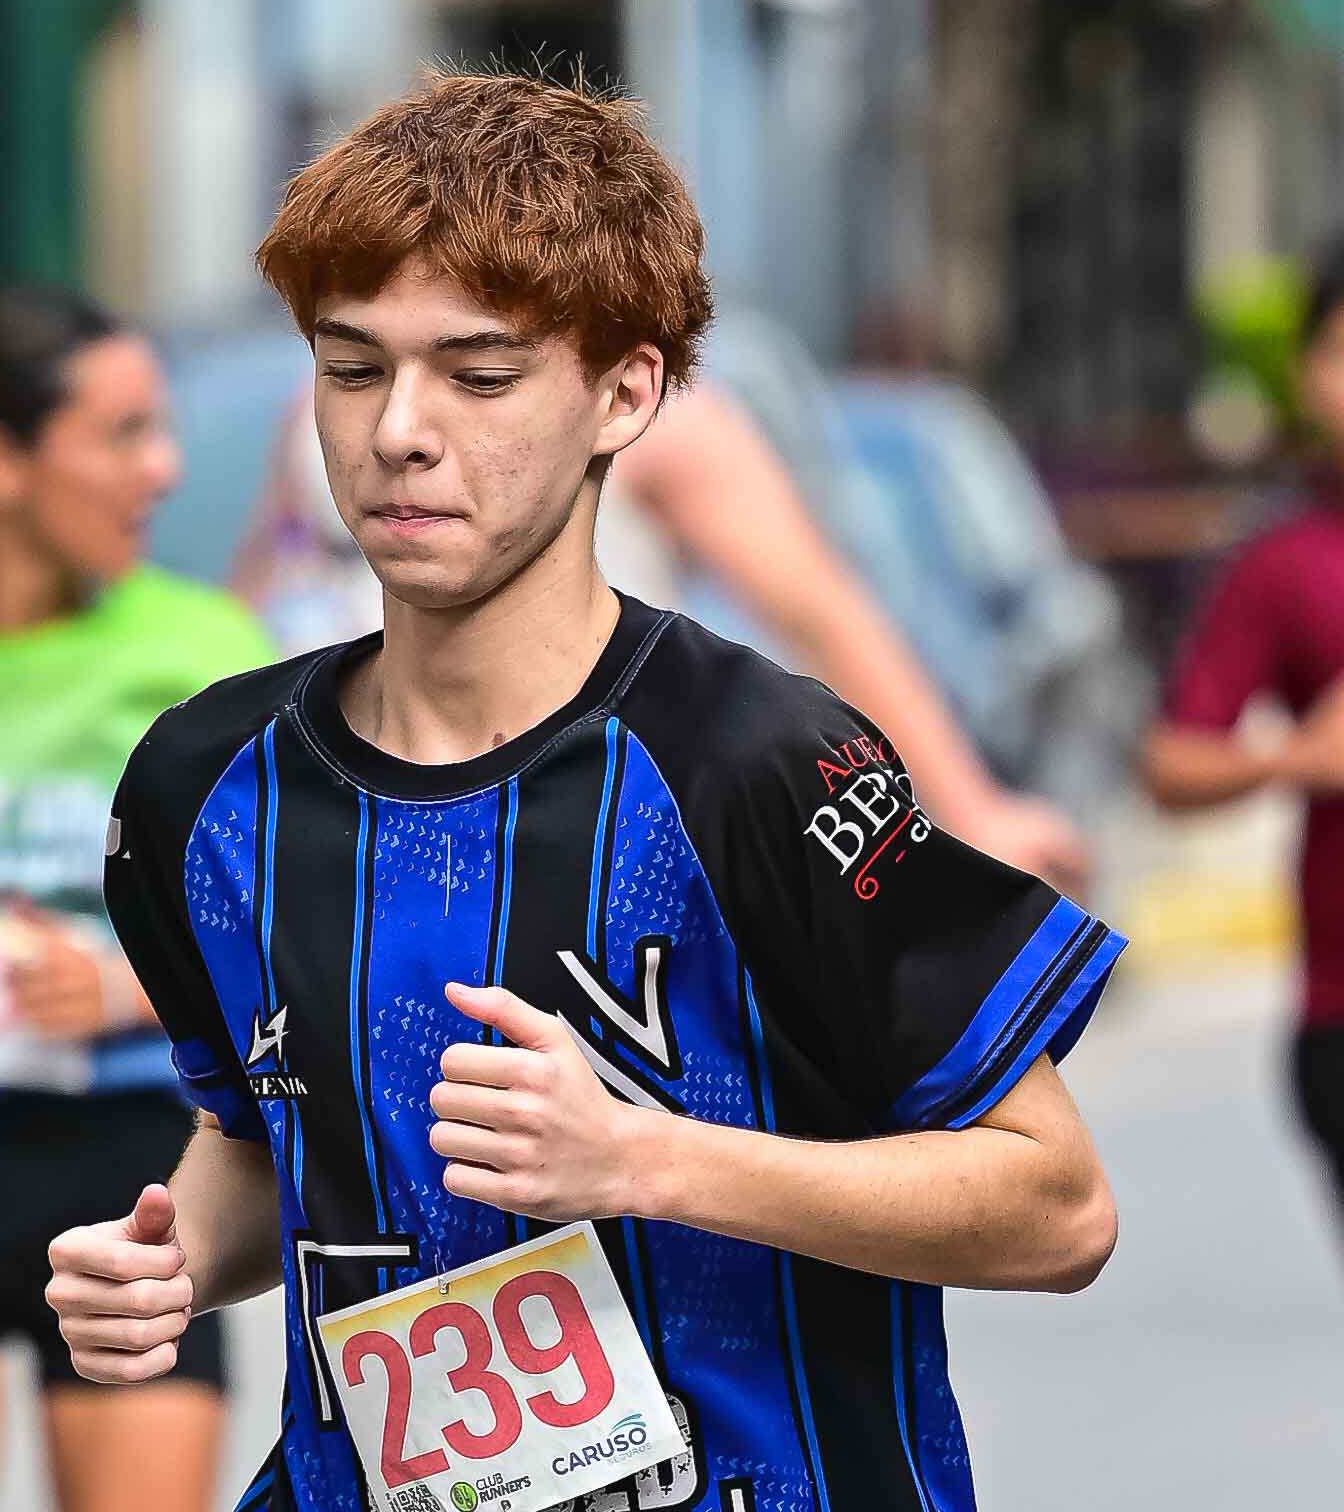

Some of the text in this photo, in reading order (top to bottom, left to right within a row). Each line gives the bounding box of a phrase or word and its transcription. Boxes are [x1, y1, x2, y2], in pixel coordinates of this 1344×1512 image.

[341, 1269, 616, 1490] 239
[551, 1426, 647, 1476] CARUSO
[475, 1472, 504, 1491] CLUB
[479, 1475, 533, 1504] RUNNER'S
